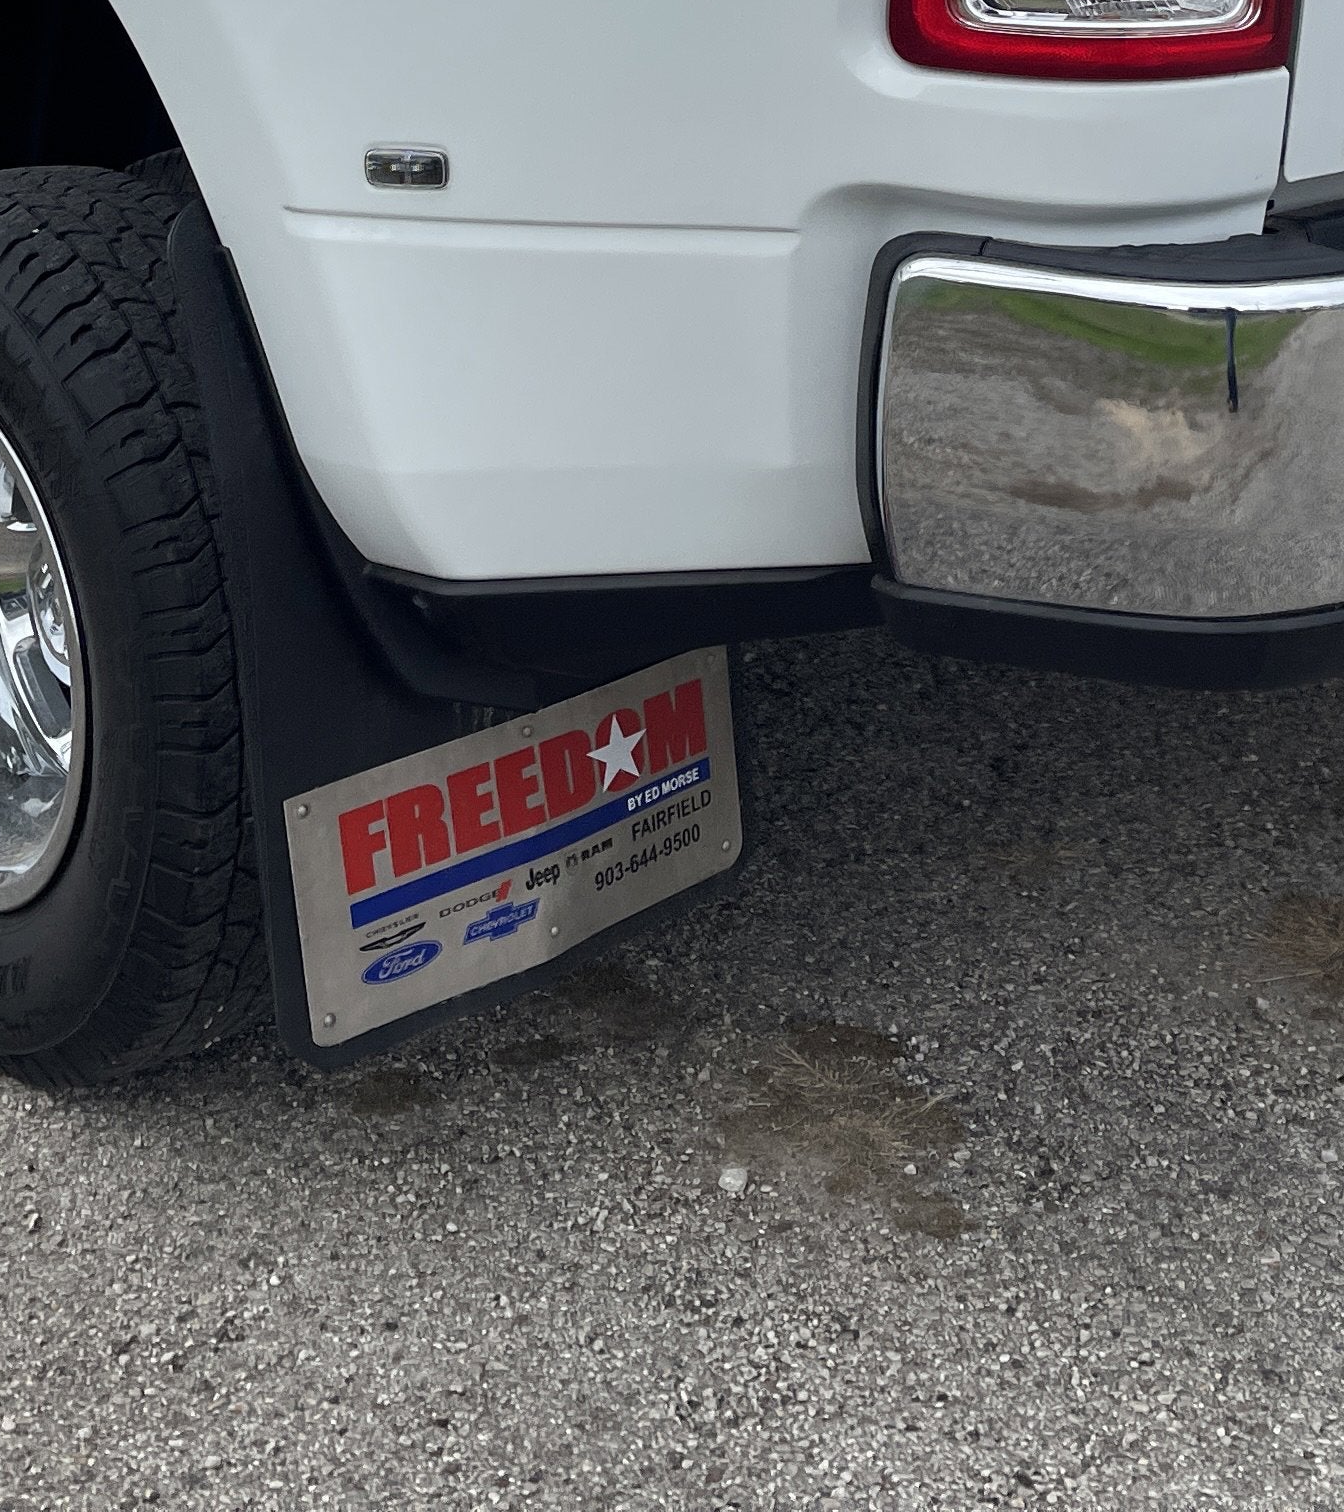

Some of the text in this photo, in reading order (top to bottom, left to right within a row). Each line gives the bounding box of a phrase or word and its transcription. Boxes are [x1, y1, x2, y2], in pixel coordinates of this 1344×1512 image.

[338, 678, 708, 896] FREEDOM
[627, 767, 700, 811] BY ED MORSE
[631, 789, 712, 842] FAIRFIELD
[580, 838, 614, 862] RAM
[594, 823, 701, 891] 903-644-9500
[526, 863, 561, 891] Jeep
[439, 888, 500, 919] DODGE
[365, 913, 420, 938] CHRYSLER
[469, 905, 535, 937] CHEVROLET
[378, 949, 427, 980] Ford
